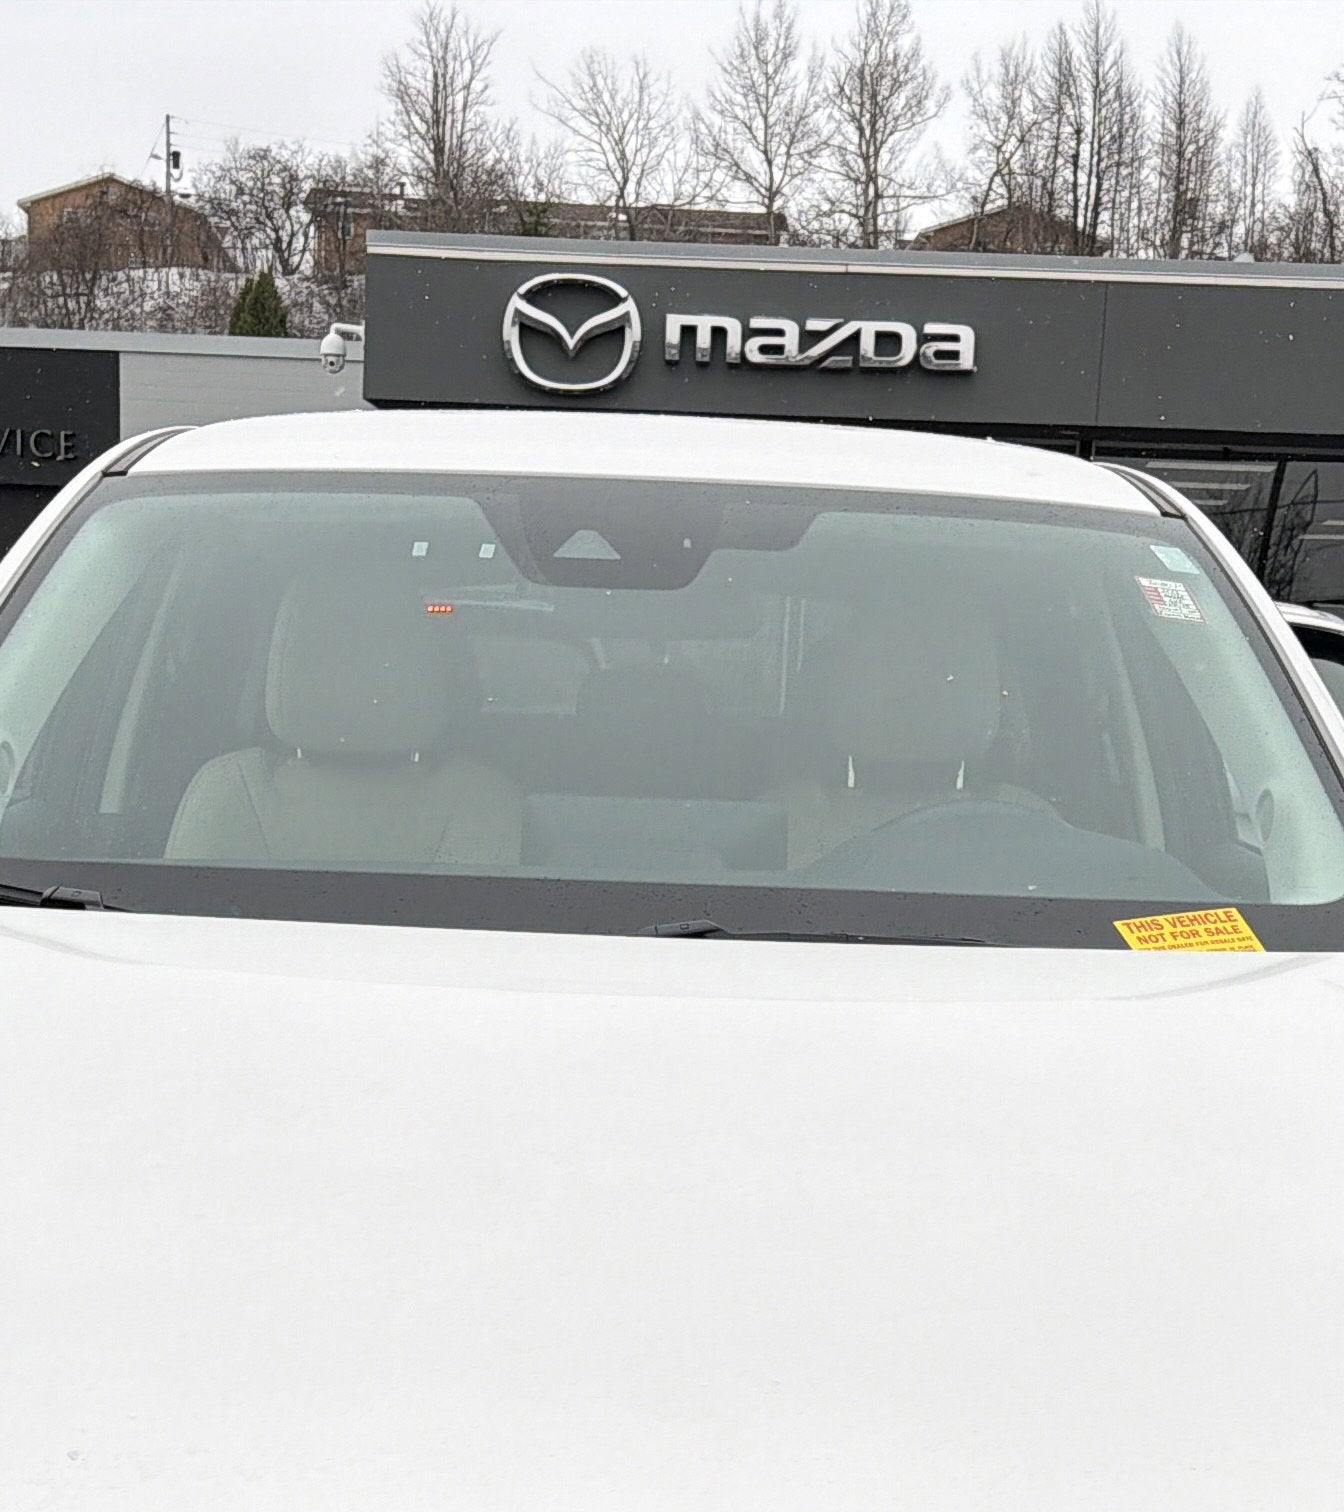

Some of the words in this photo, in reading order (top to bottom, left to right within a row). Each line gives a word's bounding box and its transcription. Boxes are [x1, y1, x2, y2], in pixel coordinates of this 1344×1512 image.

[665, 313, 976, 372] mazda
[1121, 918, 1165, 934] THIS
[1164, 910, 1239, 929] VEHICLE
[1136, 933, 1168, 946] NOT
[1169, 929, 1203, 942] FOR
[1204, 925, 1243, 937] SALE
